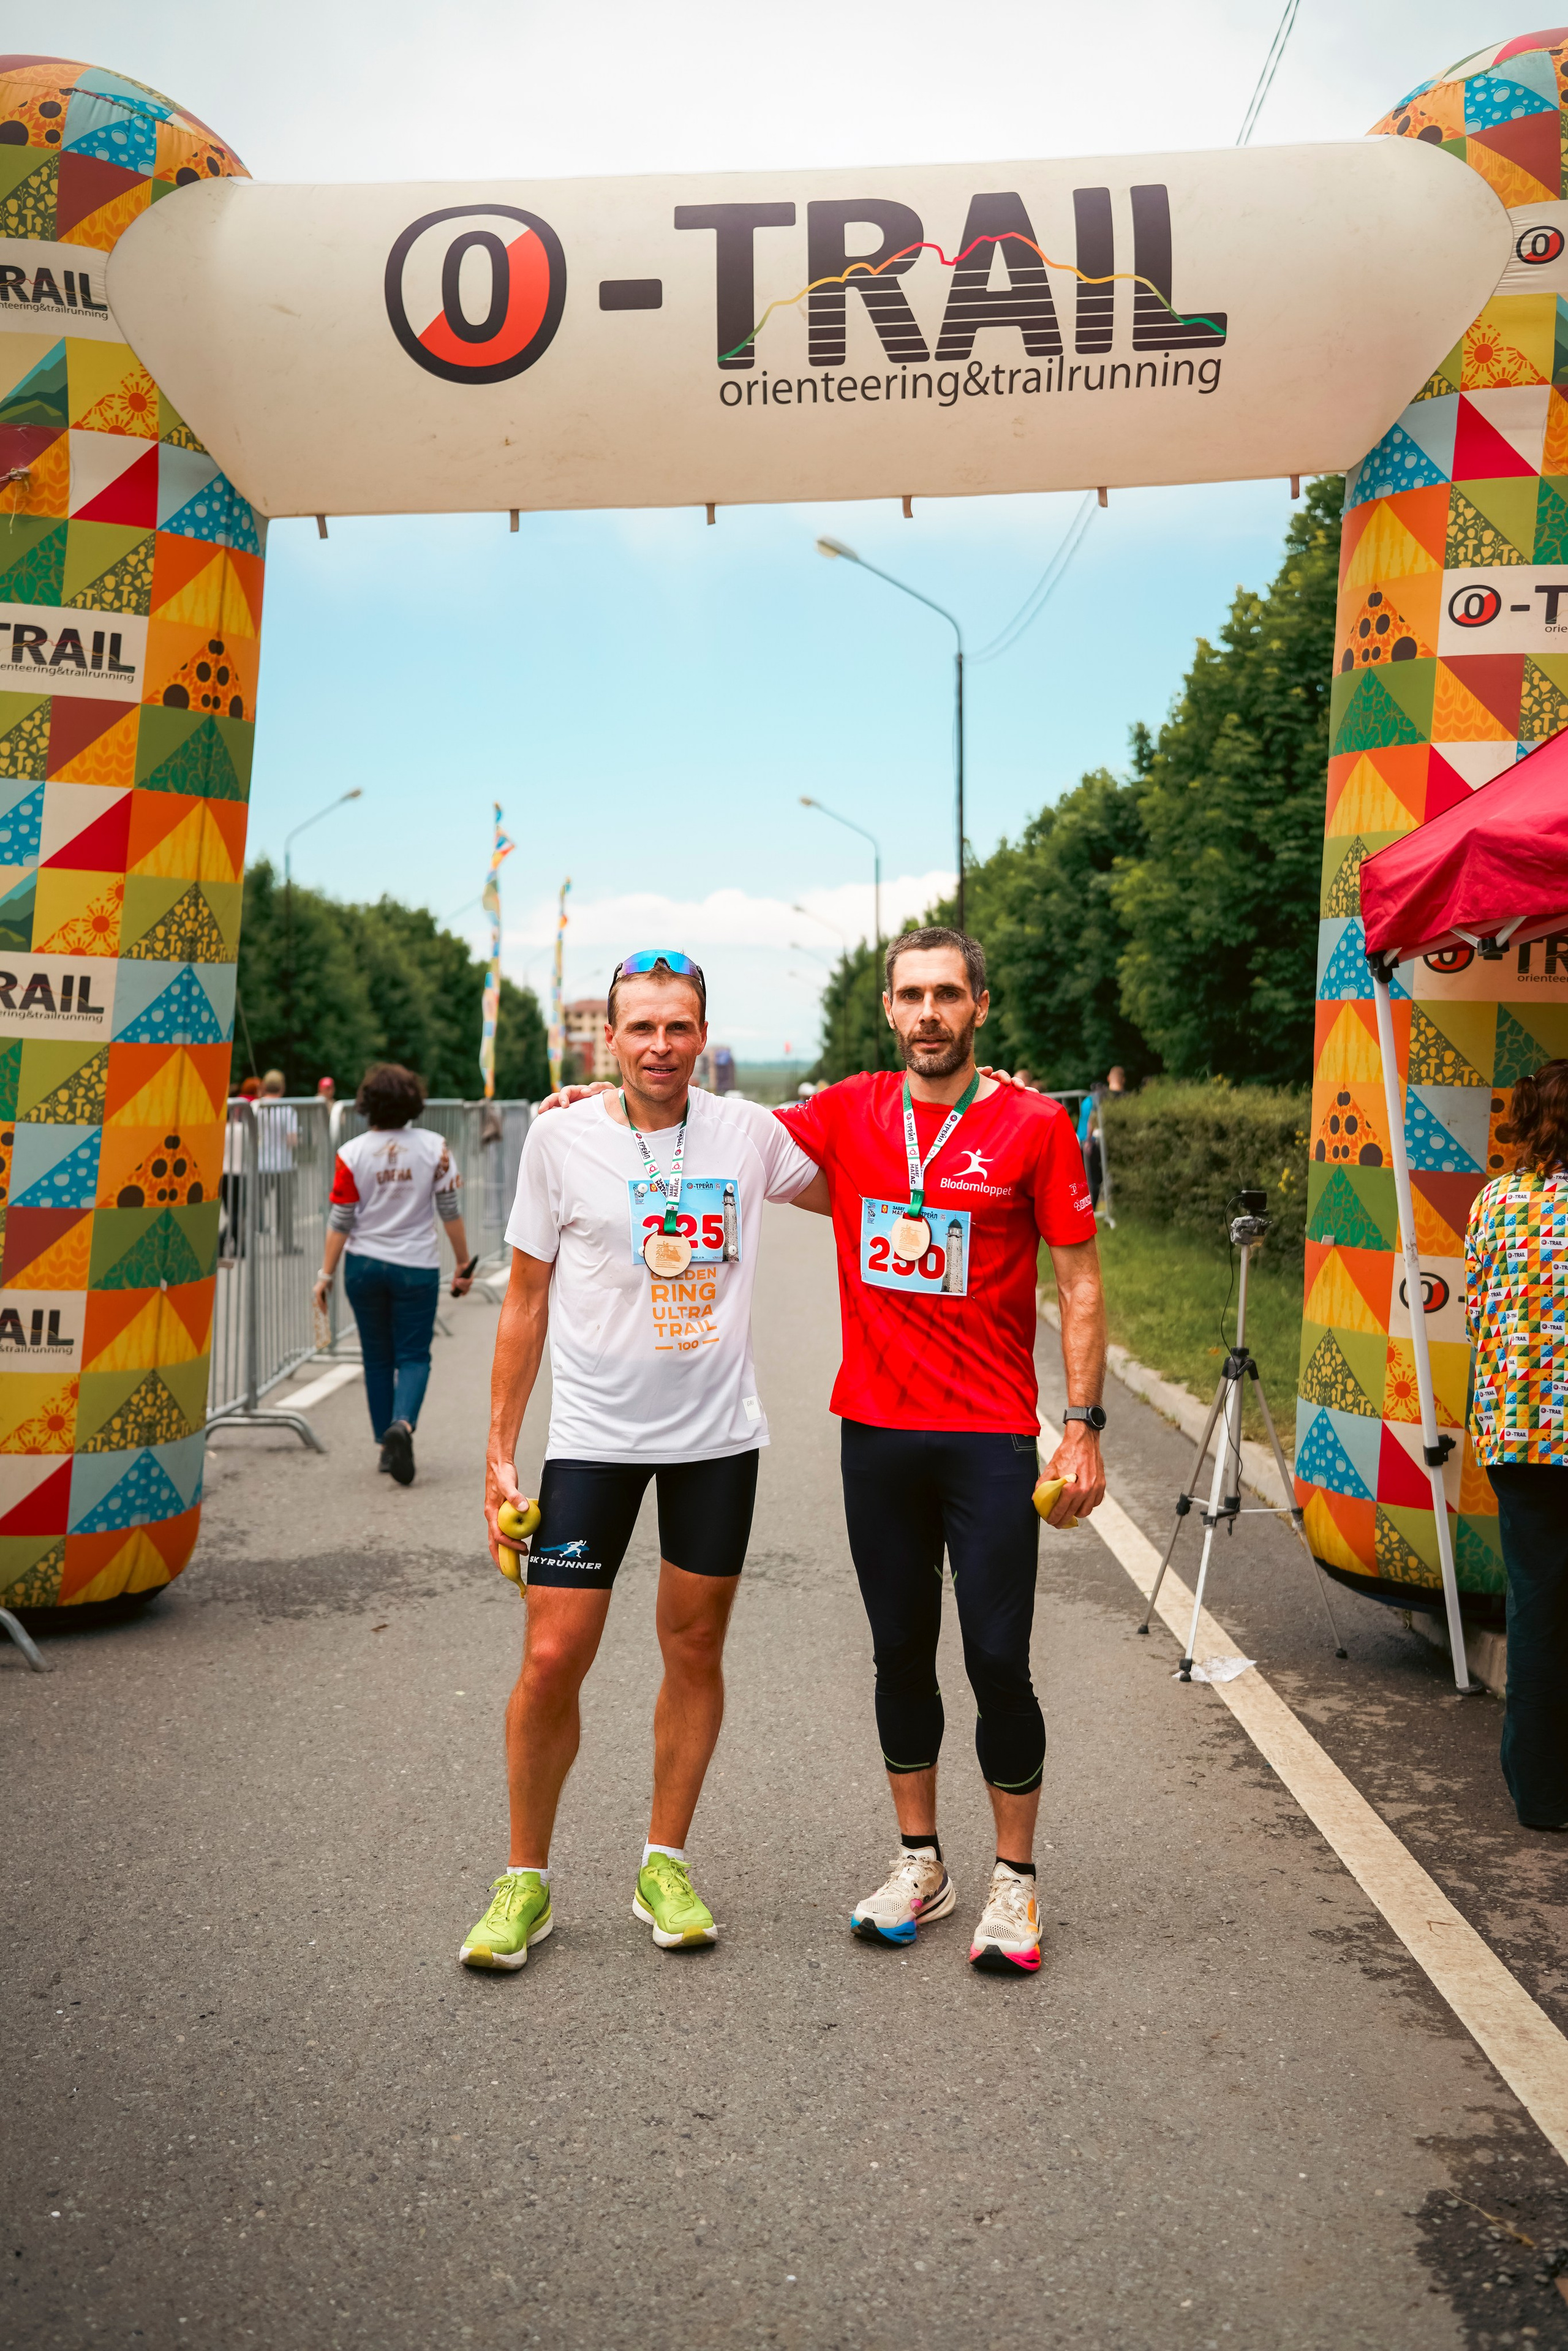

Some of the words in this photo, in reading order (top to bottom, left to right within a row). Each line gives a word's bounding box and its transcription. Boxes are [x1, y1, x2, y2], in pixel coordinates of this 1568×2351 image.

[719, 353, 1221, 407] orienteering&trailrunning
[1545, 624, 1568, 633] orie
[940, 1177, 1011, 1197] Blodomloppet
[651, 1282, 715, 1302] RING
[652, 1304, 713, 1319] ULTRA
[654, 1319, 717, 1337] TRAIL
[677, 1340, 699, 1351] 100
[529, 1556, 602, 1569] SKYRUNNER
